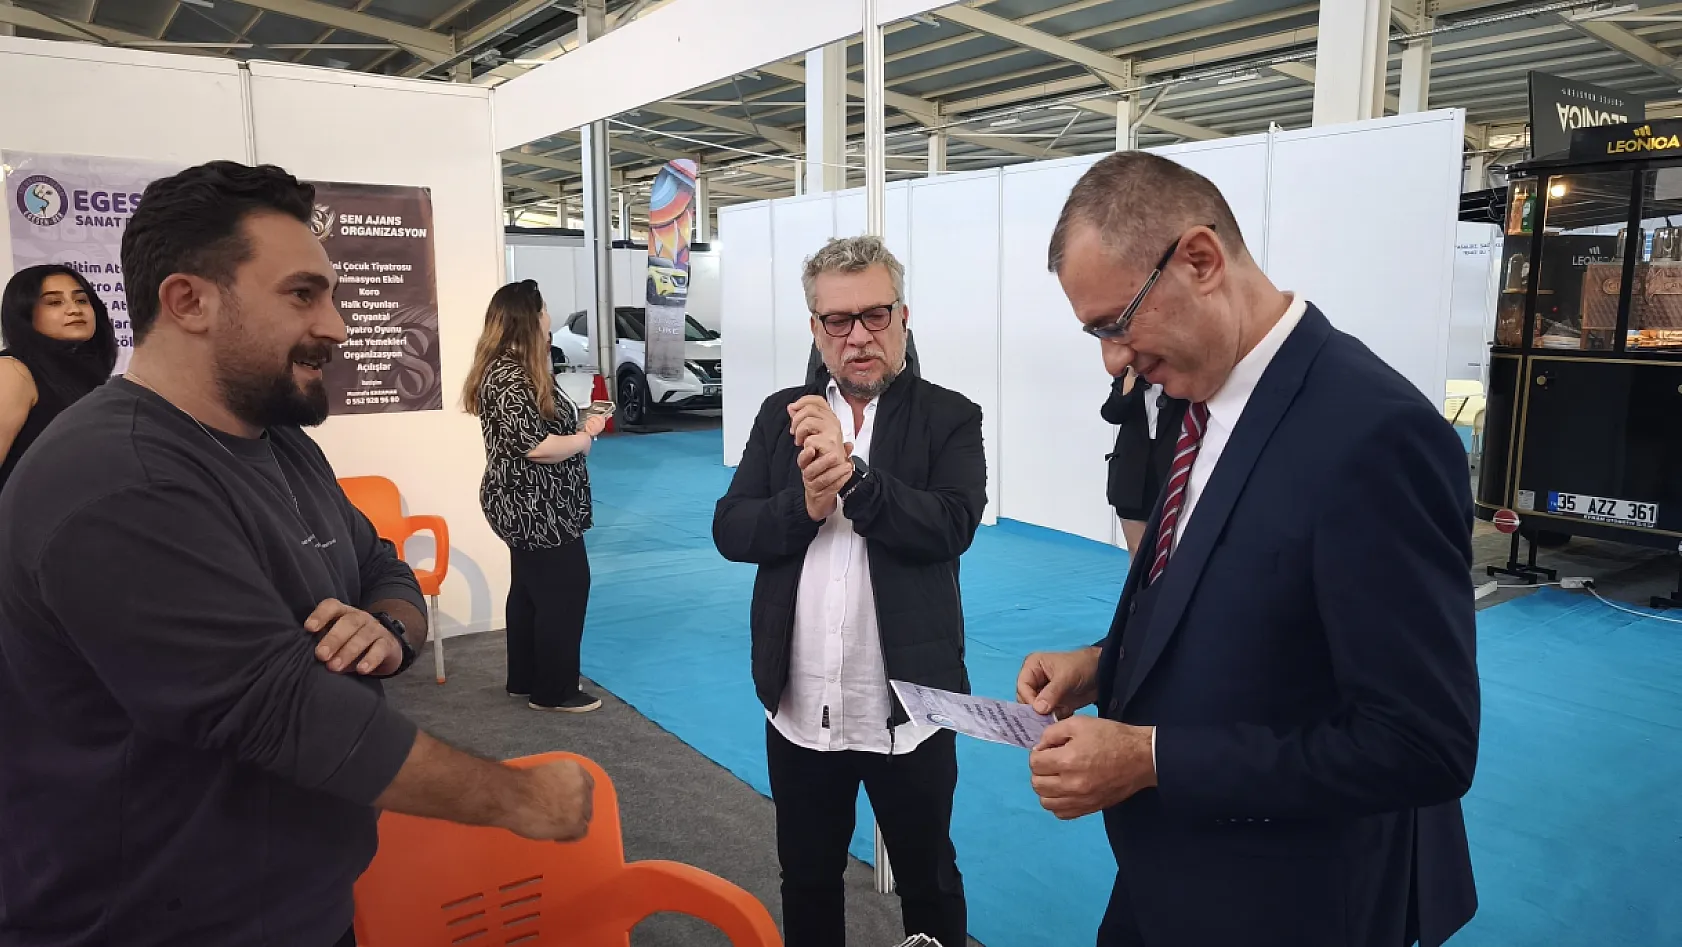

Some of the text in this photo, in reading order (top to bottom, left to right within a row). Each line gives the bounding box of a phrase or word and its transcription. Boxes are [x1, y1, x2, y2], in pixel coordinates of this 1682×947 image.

[75, 215, 122, 228] SANAT
[340, 213, 402, 226] SEN AJANS
[343, 261, 370, 272] Çocuk
[371, 261, 412, 272] Tiyatrosu
[339, 275, 404, 285] nimasyon Ekibi
[358, 288, 380, 296] Koro
[340, 300, 361, 309] Halk
[352, 313, 390, 322] Oryantal
[345, 325, 402, 335] iyatro Oyunu
[1558, 494, 1655, 522] 35 AZZ 361
